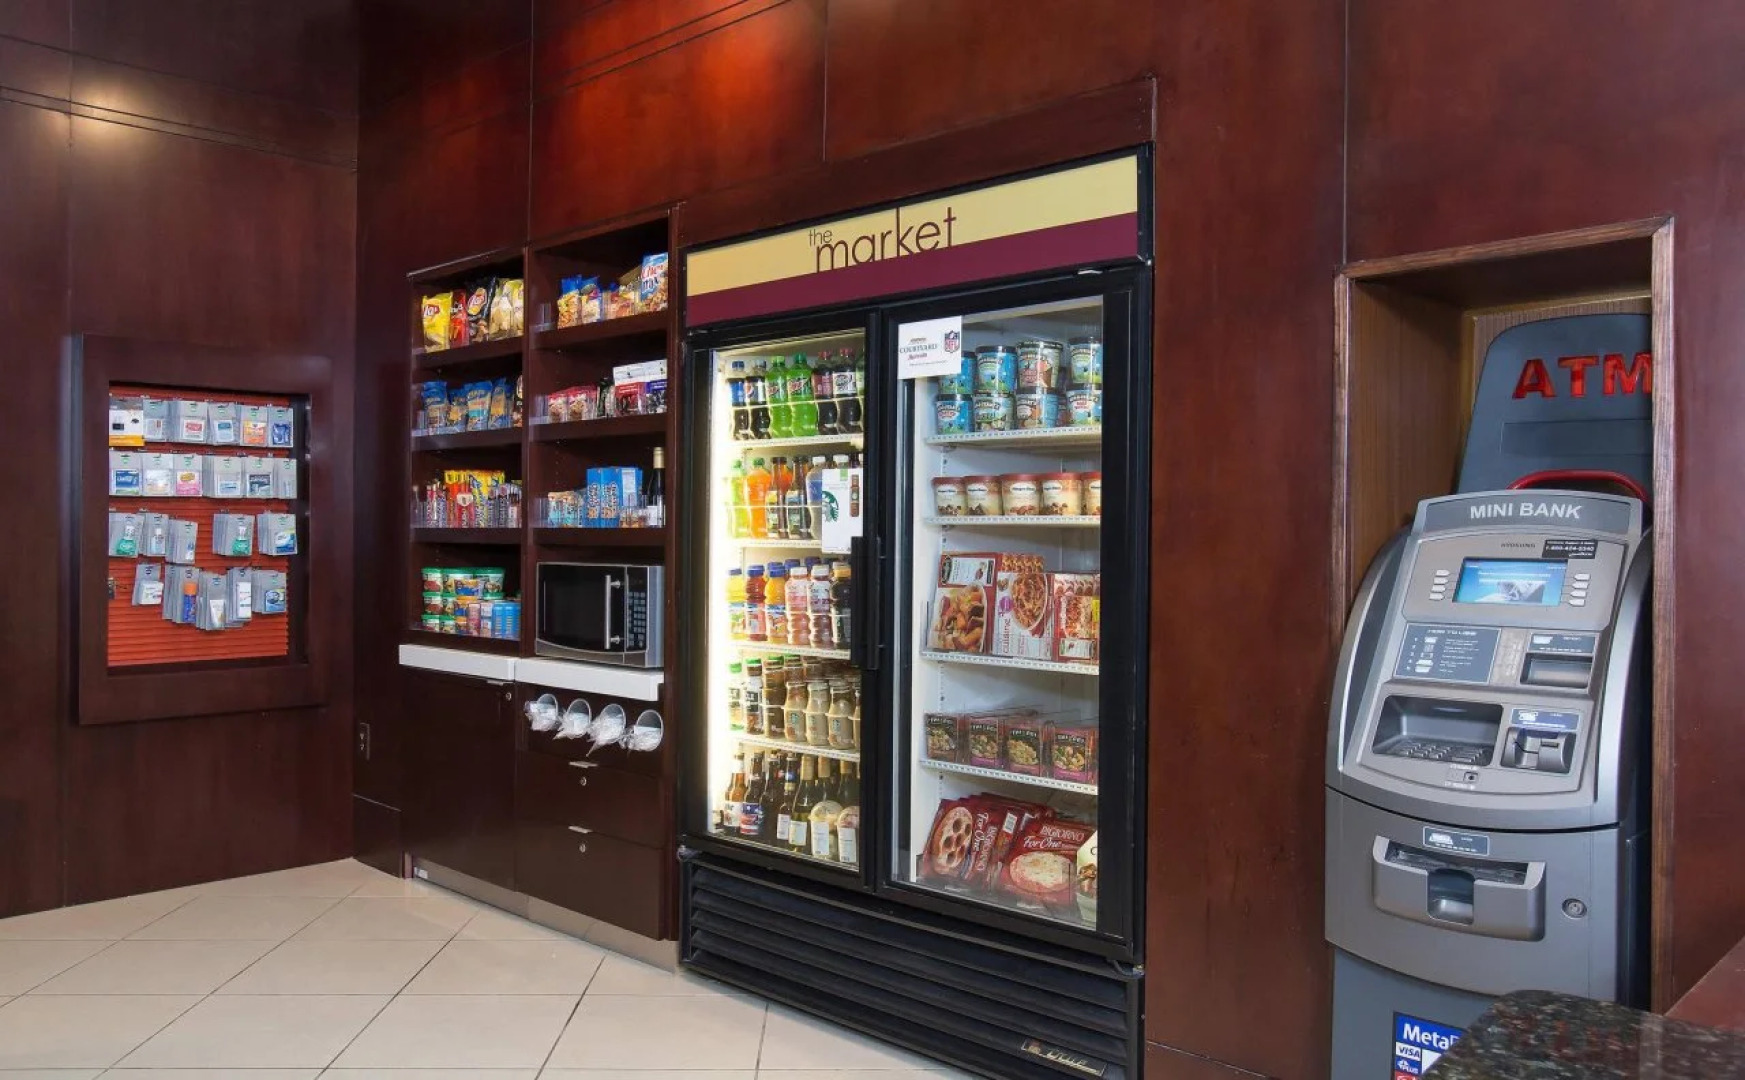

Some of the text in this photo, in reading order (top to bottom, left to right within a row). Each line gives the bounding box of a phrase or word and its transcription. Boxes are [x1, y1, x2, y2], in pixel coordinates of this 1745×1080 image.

[808, 227, 833, 247] the
[816, 206, 957, 274] market
[1512, 352, 1652, 400] ATM
[1470, 502, 1583, 520] MINI BANK
[1399, 1046, 1420, 1059] VISA
